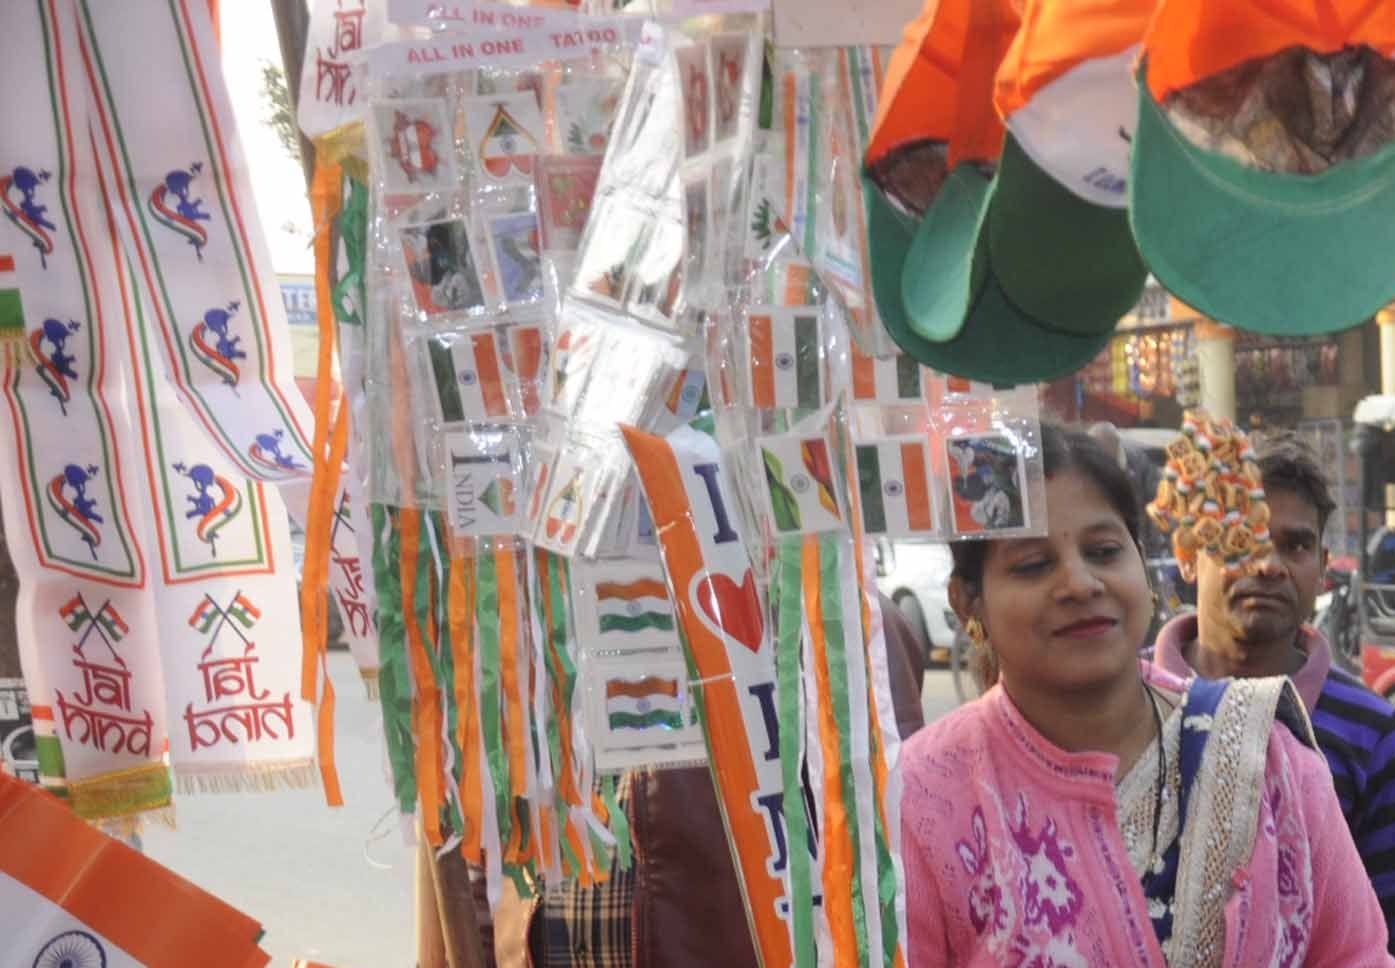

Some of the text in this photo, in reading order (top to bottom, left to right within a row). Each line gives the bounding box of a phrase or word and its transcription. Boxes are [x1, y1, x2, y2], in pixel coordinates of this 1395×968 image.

[407, 47, 447, 63] ALL
[451, 44, 474, 59] IN
[480, 37, 525, 55] ONE
[694, 463, 738, 544] I
